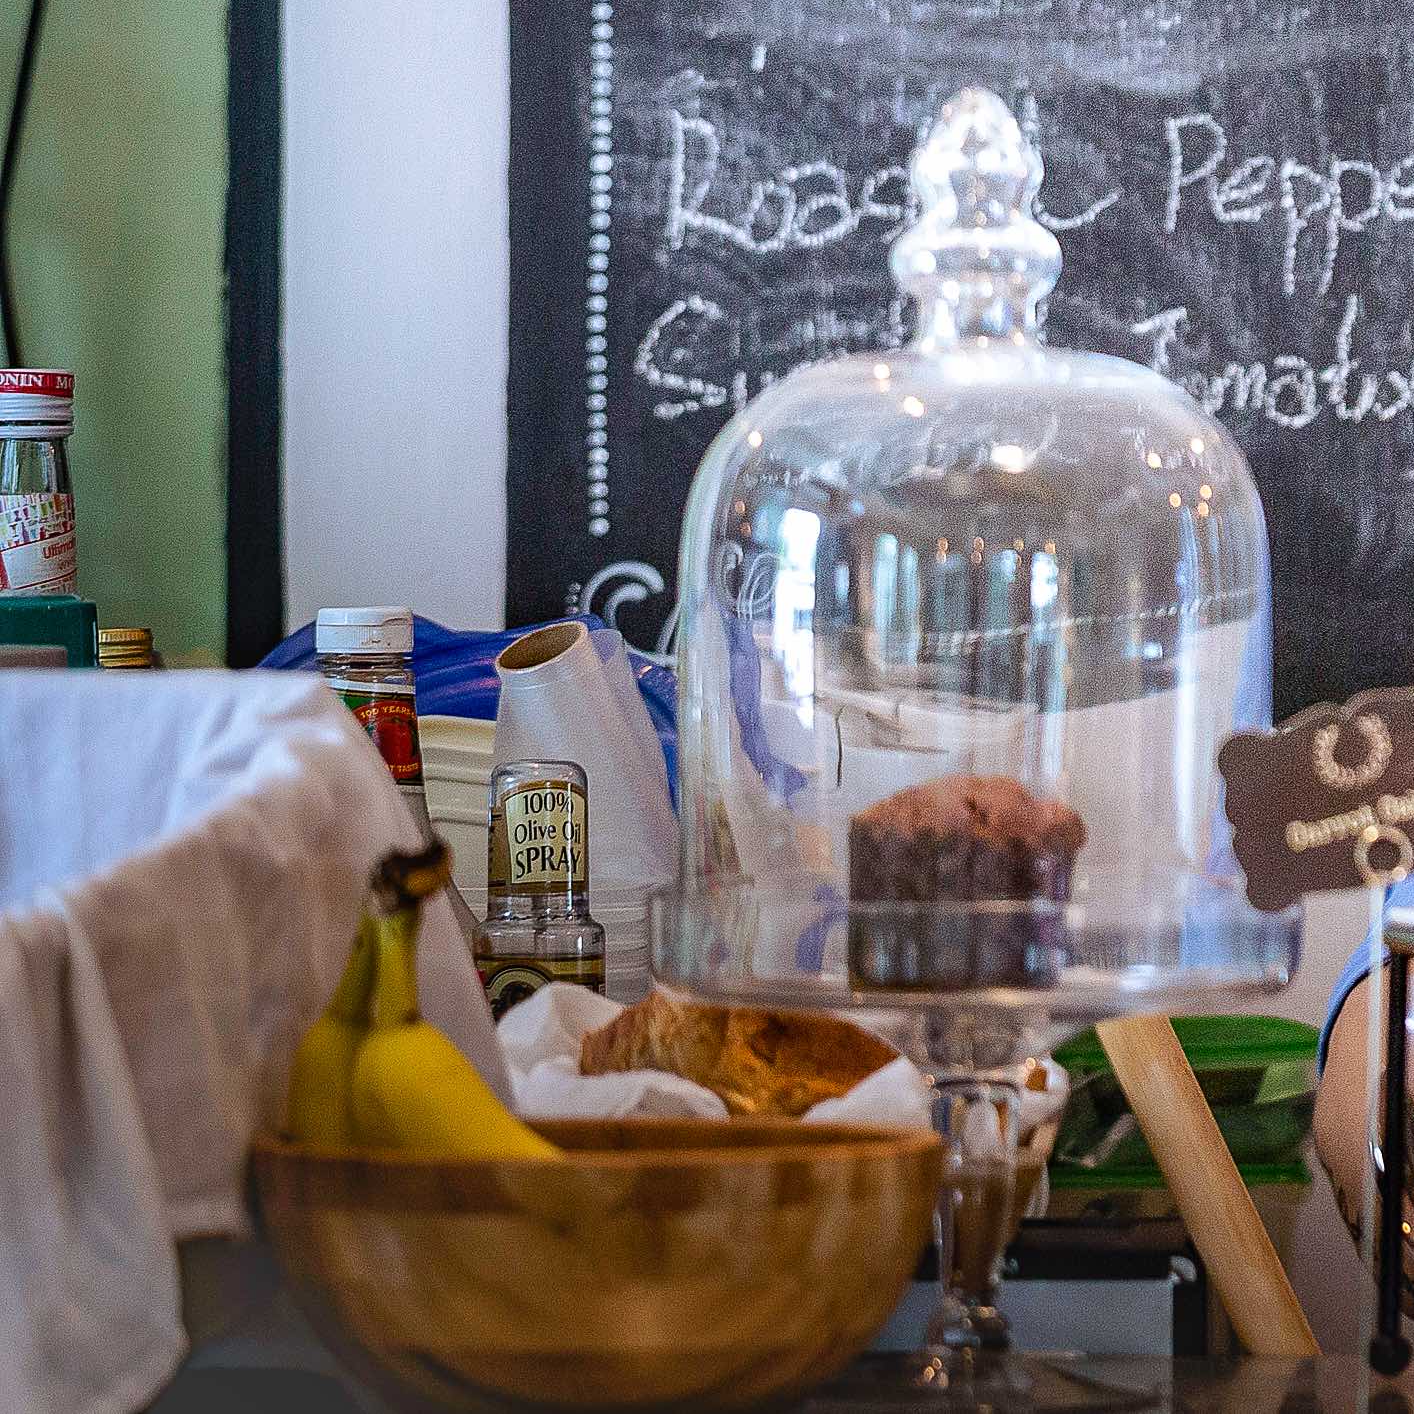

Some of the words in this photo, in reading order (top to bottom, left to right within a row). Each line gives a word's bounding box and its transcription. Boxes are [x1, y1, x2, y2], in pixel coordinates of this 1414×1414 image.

[523, 791, 574, 817] 100%
[514, 820, 557, 846] Olive
[563, 819, 582, 845] Oil
[516, 846, 582, 880] SPRAY
